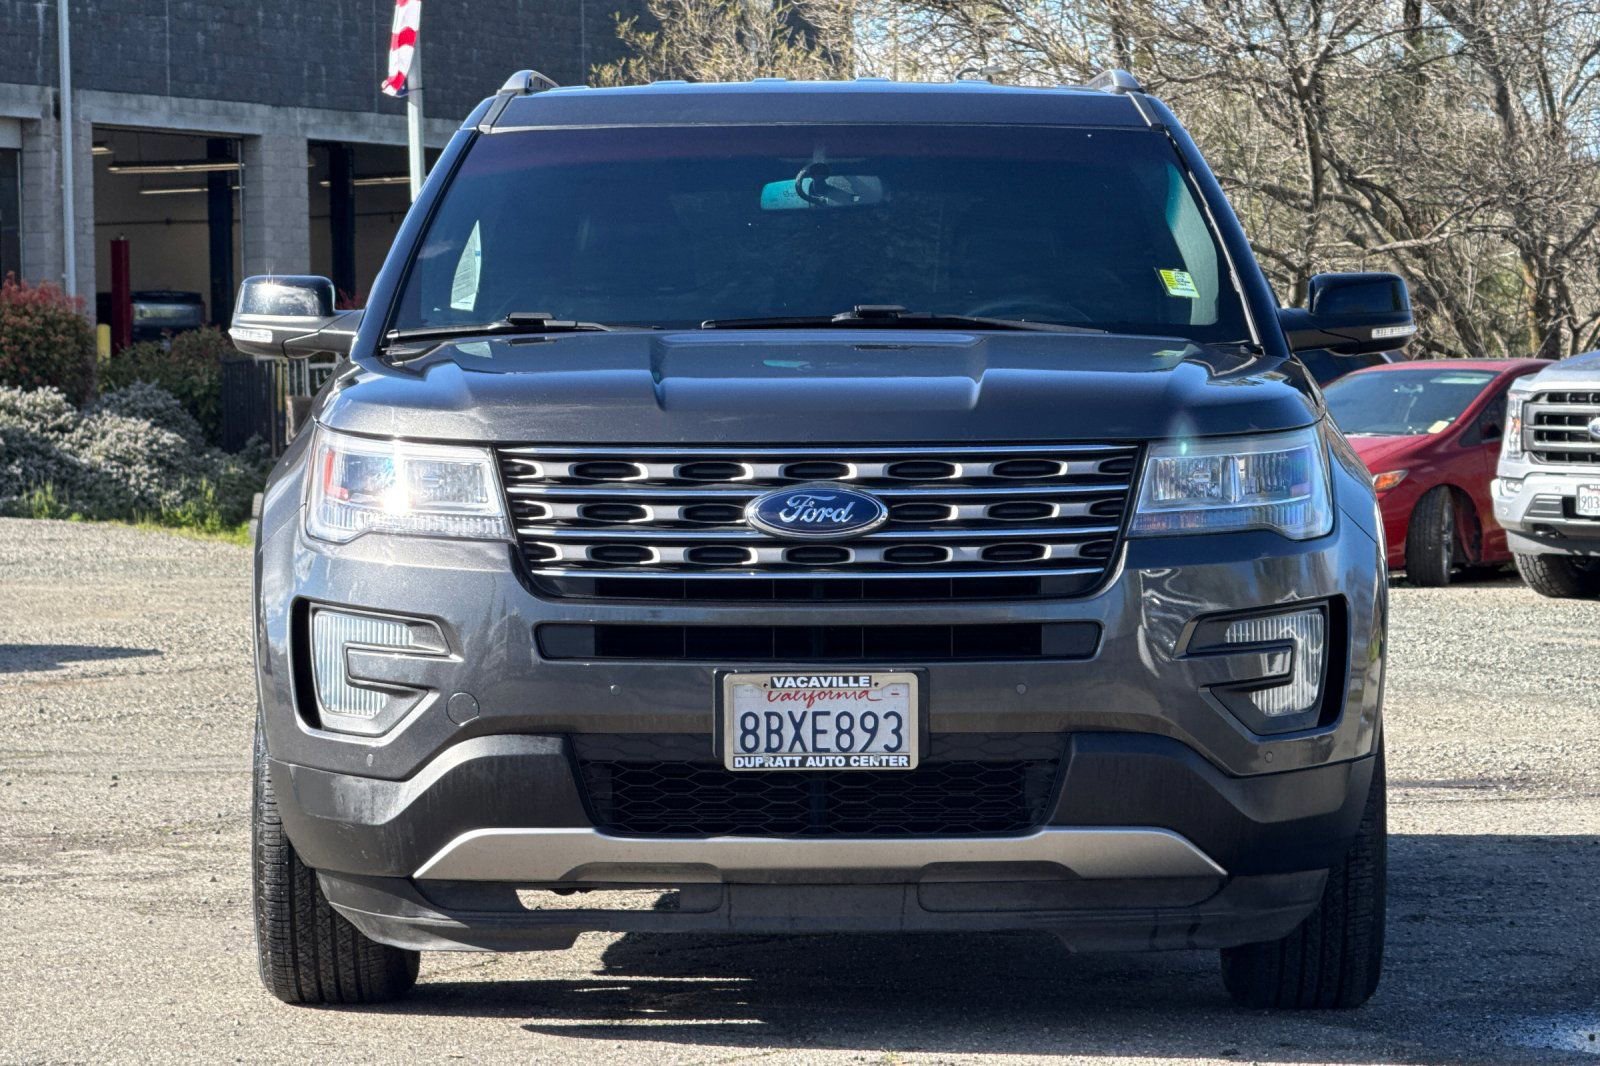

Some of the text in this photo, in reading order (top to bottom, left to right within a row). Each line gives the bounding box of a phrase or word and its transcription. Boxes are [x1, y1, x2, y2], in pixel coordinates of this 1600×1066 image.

[779, 494, 855, 523] Ford
[772, 676, 870, 688] VACAVILLE
[767, 690, 882, 709] California
[740, 711, 902, 753] 8BXE893
[734, 755, 908, 768] DUPRATT AUTO CENTER
